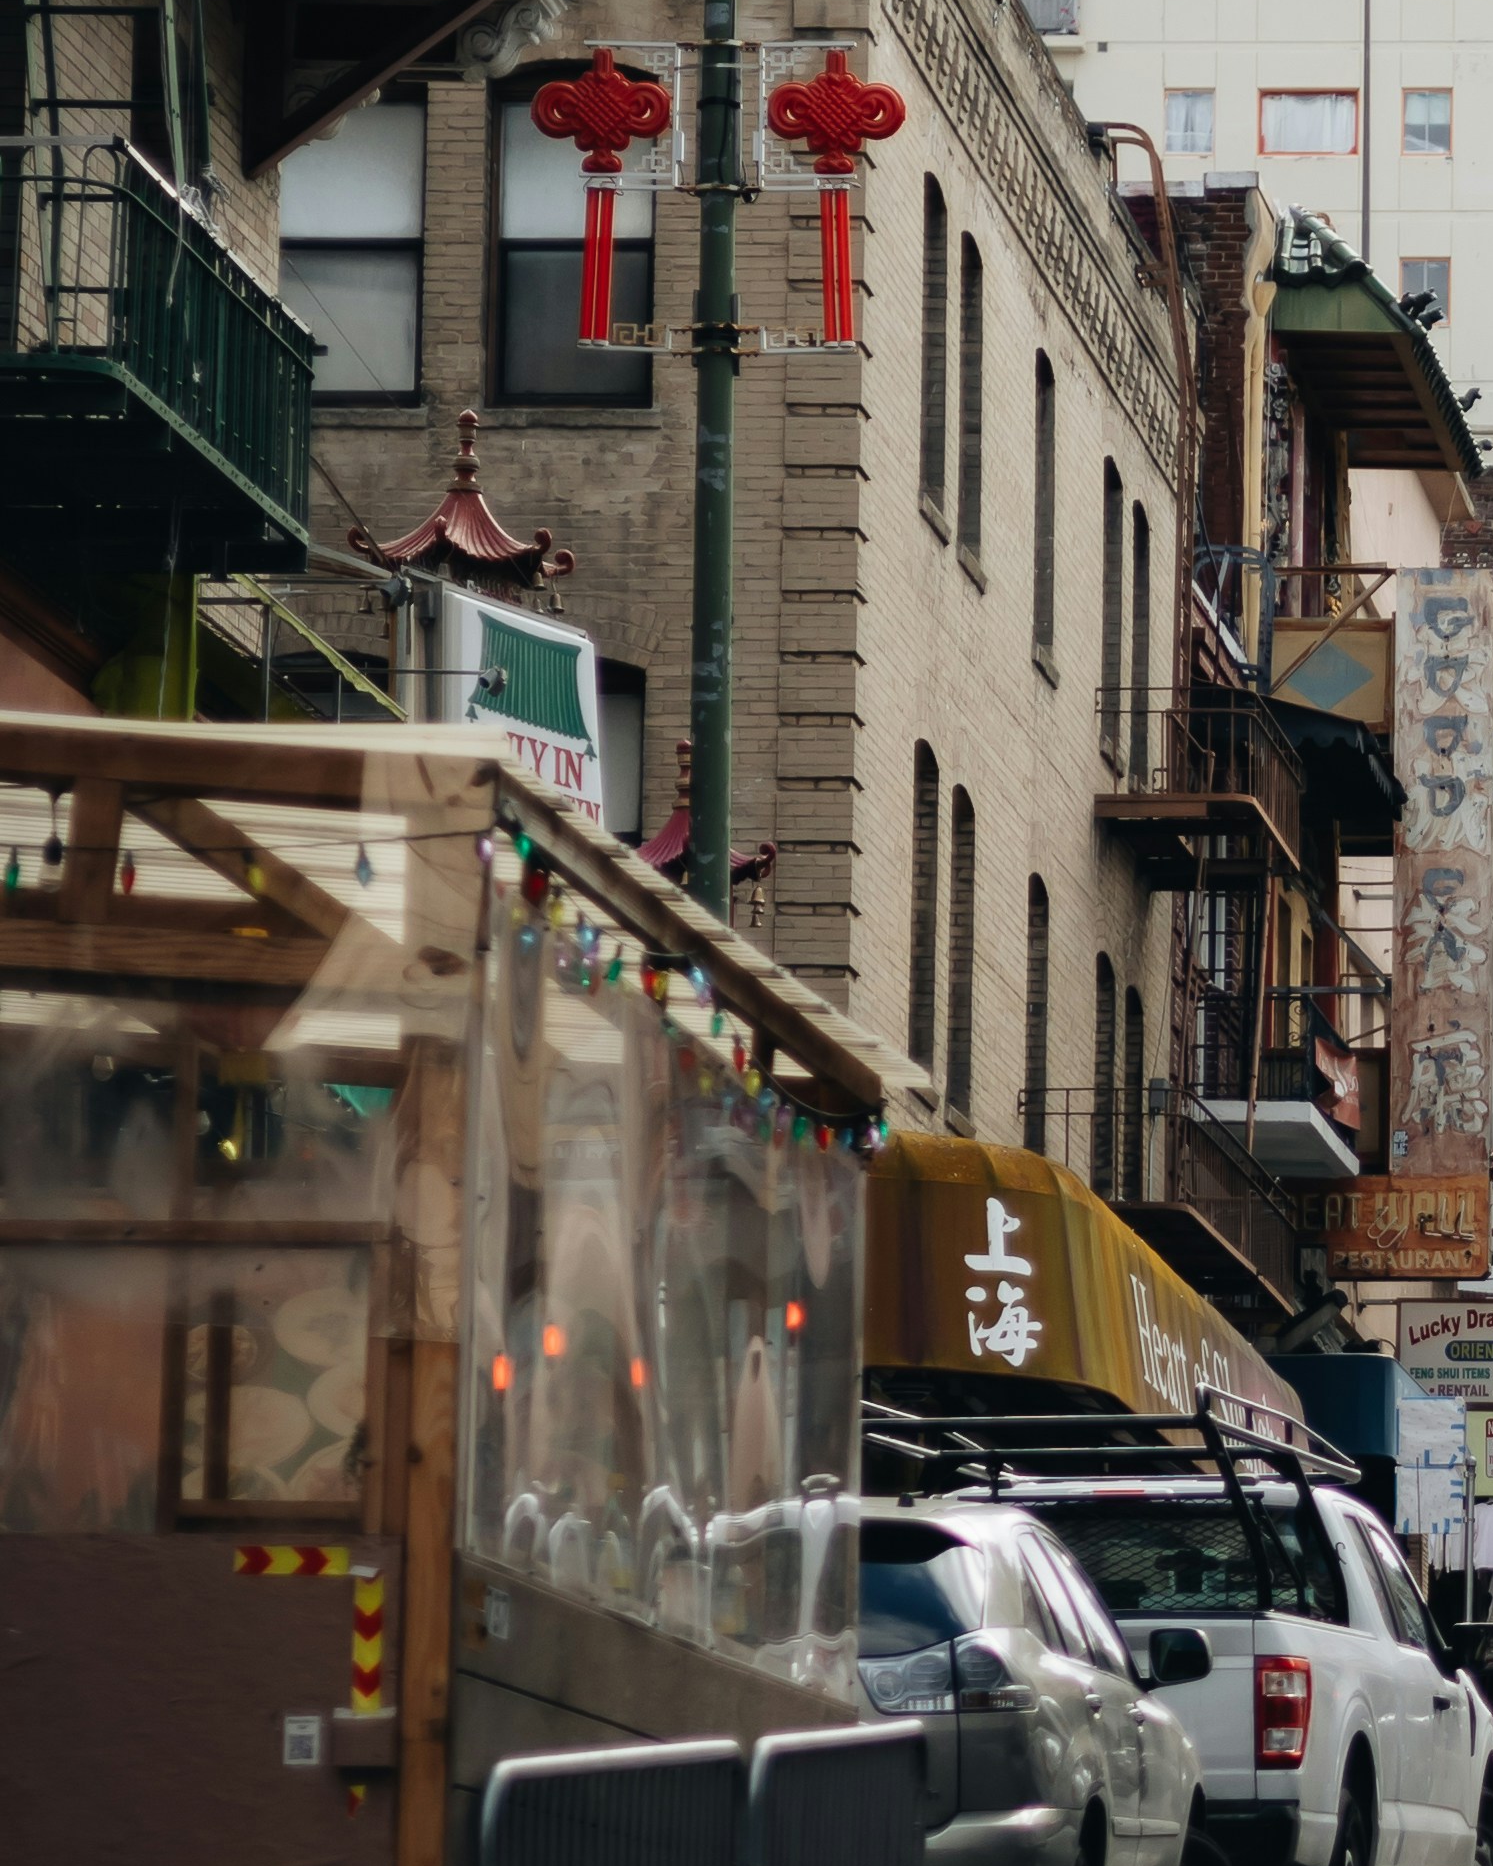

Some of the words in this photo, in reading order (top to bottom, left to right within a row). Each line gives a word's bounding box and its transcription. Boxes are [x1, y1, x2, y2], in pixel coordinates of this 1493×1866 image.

[552, 746, 585, 792] IN
[1332, 1245, 1481, 1271] RESTAURANT
[963, 1196, 1043, 1368] 上海
[1130, 1274, 1193, 1415] Heart
[1408, 1314, 1462, 1346] Lucky
[1410, 1368, 1435, 1380] FENG
[1437, 1368, 1460, 1380] SHUI
[1462, 1368, 1491, 1380] ITEMS
[1437, 1384, 1490, 1397] RENTAIL
